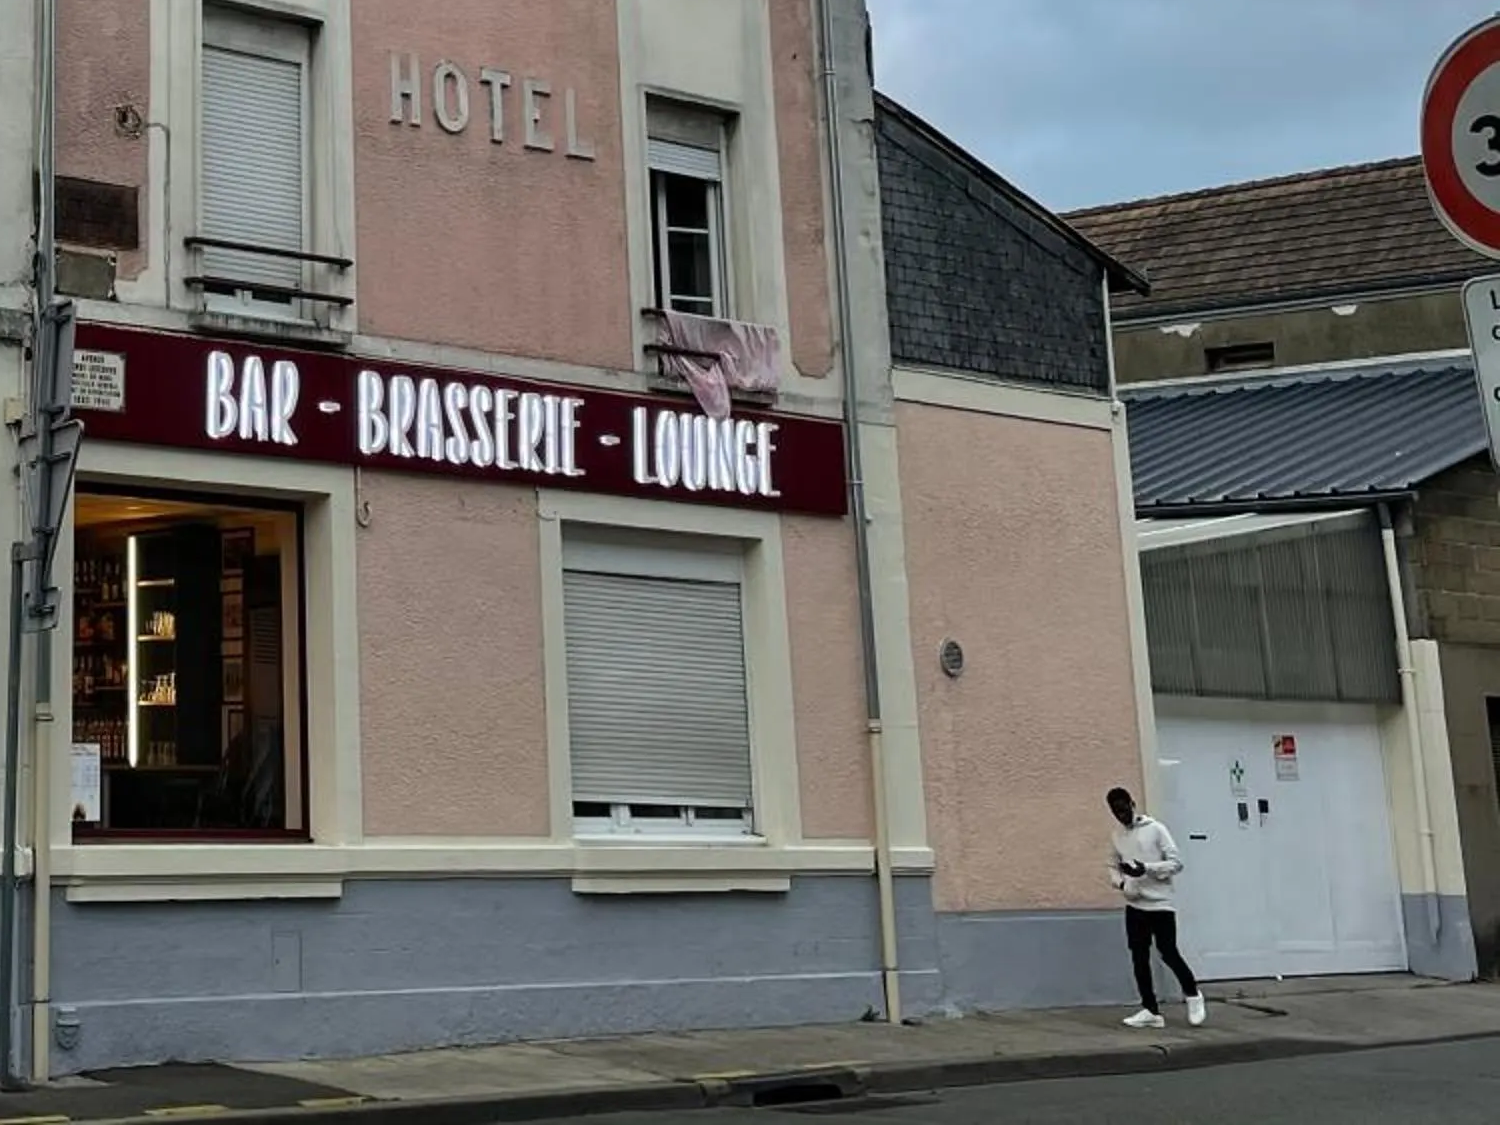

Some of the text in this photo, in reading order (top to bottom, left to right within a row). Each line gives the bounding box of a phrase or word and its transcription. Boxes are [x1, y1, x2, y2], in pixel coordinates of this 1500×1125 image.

[388, 48, 596, 161] HOTEL
[206, 350, 300, 446] BAR
[357, 370, 586, 477] BRASSERIE
[633, 405, 782, 497] LOUNGE
